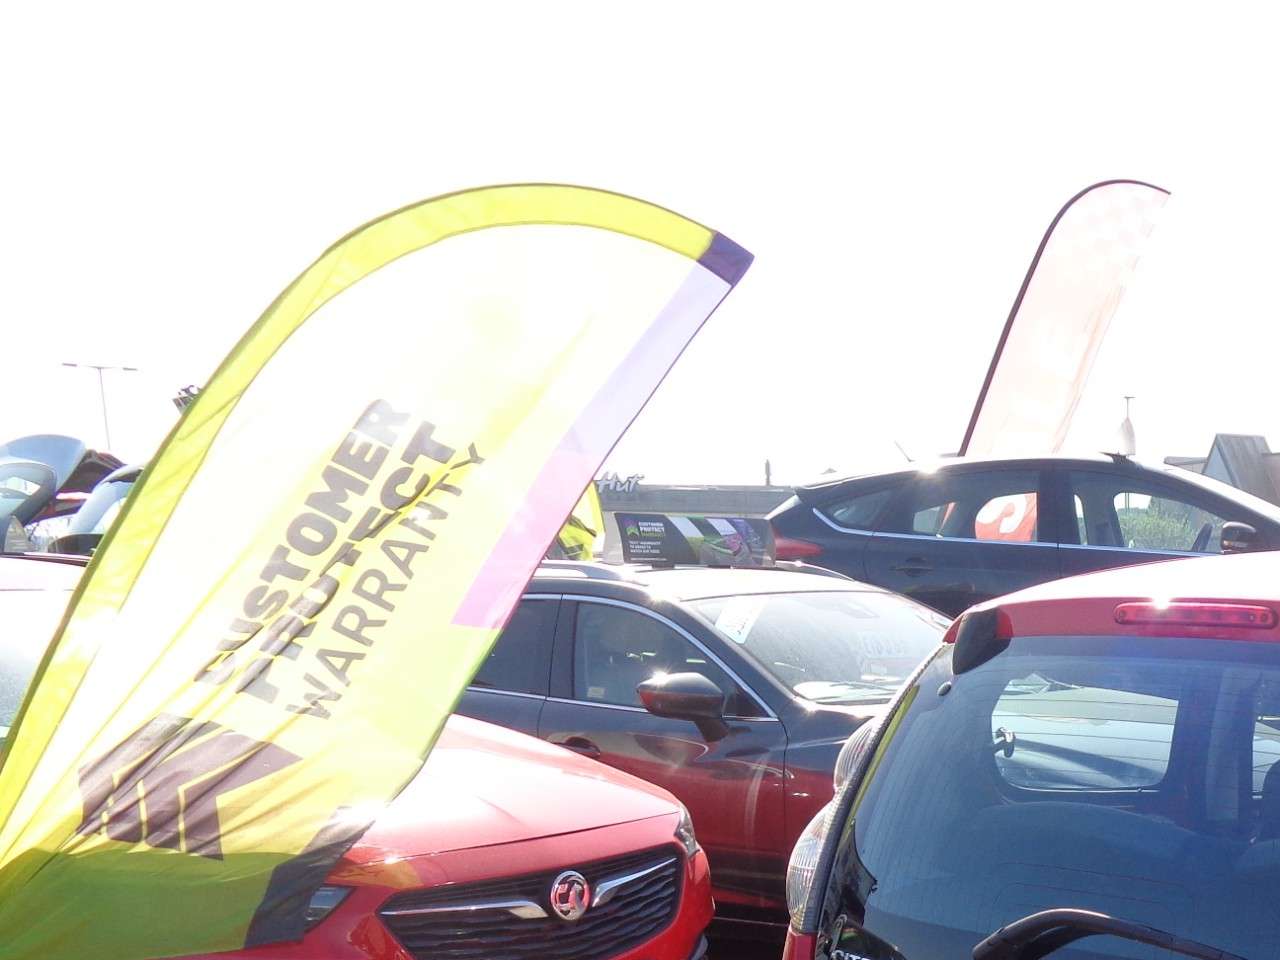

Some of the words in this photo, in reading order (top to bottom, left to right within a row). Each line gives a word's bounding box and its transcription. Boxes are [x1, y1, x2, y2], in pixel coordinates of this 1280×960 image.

[193, 398, 411, 686] CUSTOMER
[235, 420, 456, 704] PROTECT
[285, 442, 485, 720] WARRANTY
